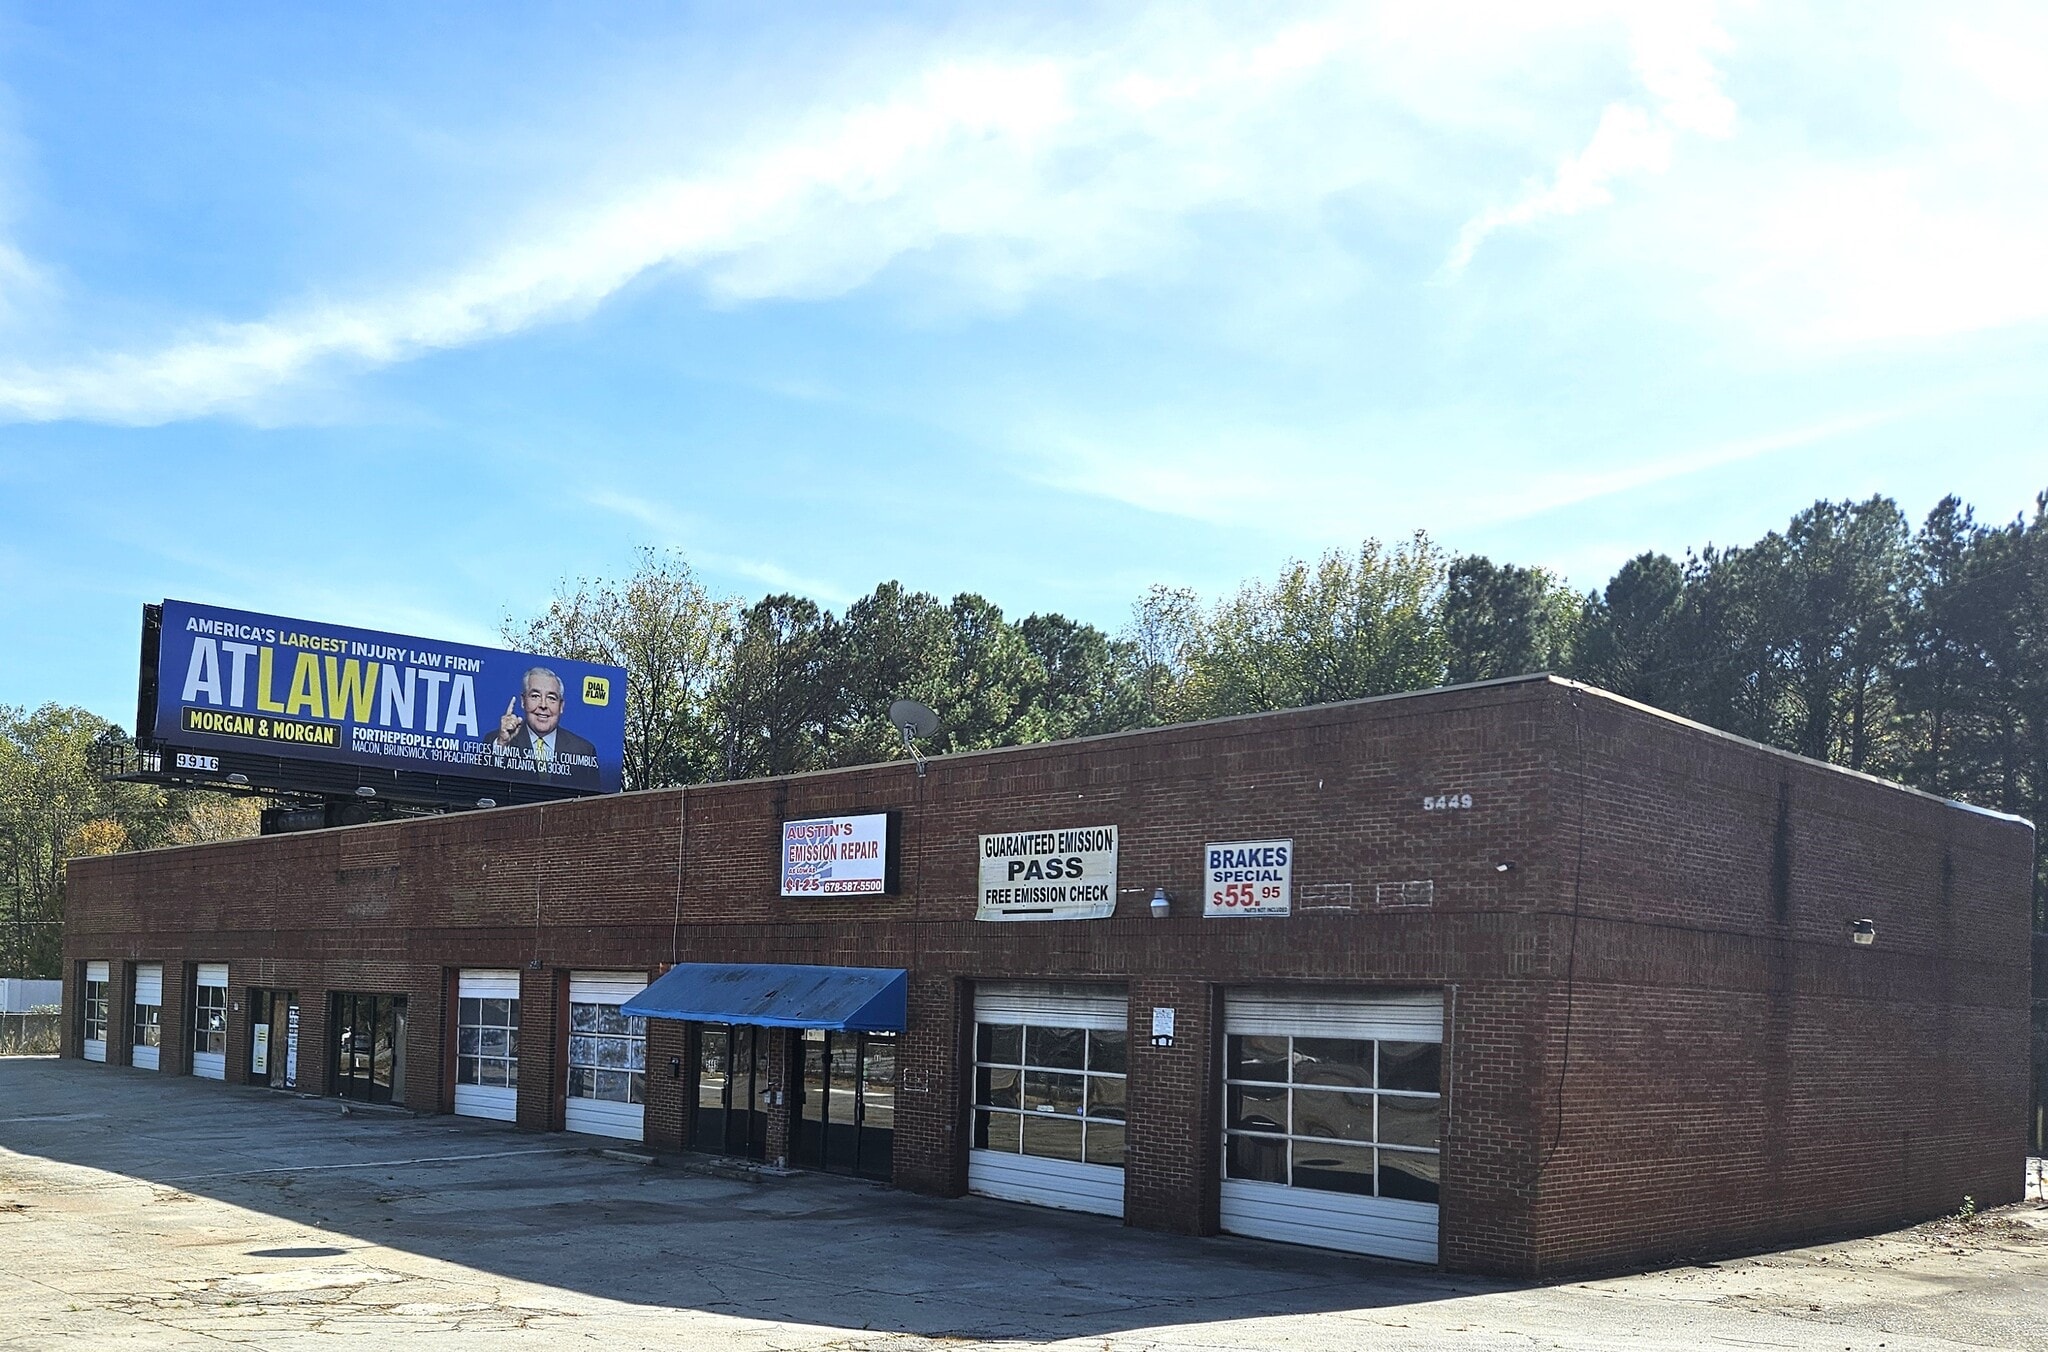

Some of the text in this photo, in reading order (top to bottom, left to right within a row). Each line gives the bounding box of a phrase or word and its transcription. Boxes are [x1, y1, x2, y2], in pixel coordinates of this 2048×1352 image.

[186, 617, 275, 643] AMERICA'S
[279, 631, 348, 654] LARGEST
[351, 642, 407, 662] INJURY
[410, 651, 441, 667] LAW
[181, 636, 479, 737] ATLAWNTA
[588, 682, 604, 691] DIAL
[190, 711, 334, 745] MORGAN & MORGAN
[352, 726, 460, 751] FORTHEPEOPLE.COM
[177, 755, 219, 770] 9916
[352, 740, 382, 756] MACON,
[431, 749, 442, 761] 191
[443, 750, 482, 766] PEACHTREE
[494, 756, 506, 770] NE,
[507, 758, 537, 773] ATLANTA,
[537, 761, 547, 773] GA
[547, 762, 572, 776] 30303.
[463, 741, 492, 755] OFFICES
[560, 752, 599, 769] COLUMBUS,
[1423, 793, 1473, 811] 5449
[787, 823, 853, 839] AUSTIN'S
[985, 828, 1113, 858] GUARANTEED EMISSION
[789, 840, 878, 862] EMISSION REPAIR
[1209, 846, 1288, 870] BRAKES
[1007, 857, 1084, 882] PASS
[1213, 869, 1283, 883] SPECIAL
[823, 880, 881, 893] 678-587-5500
[986, 884, 1109, 905] FREE EMISSION CHECK
